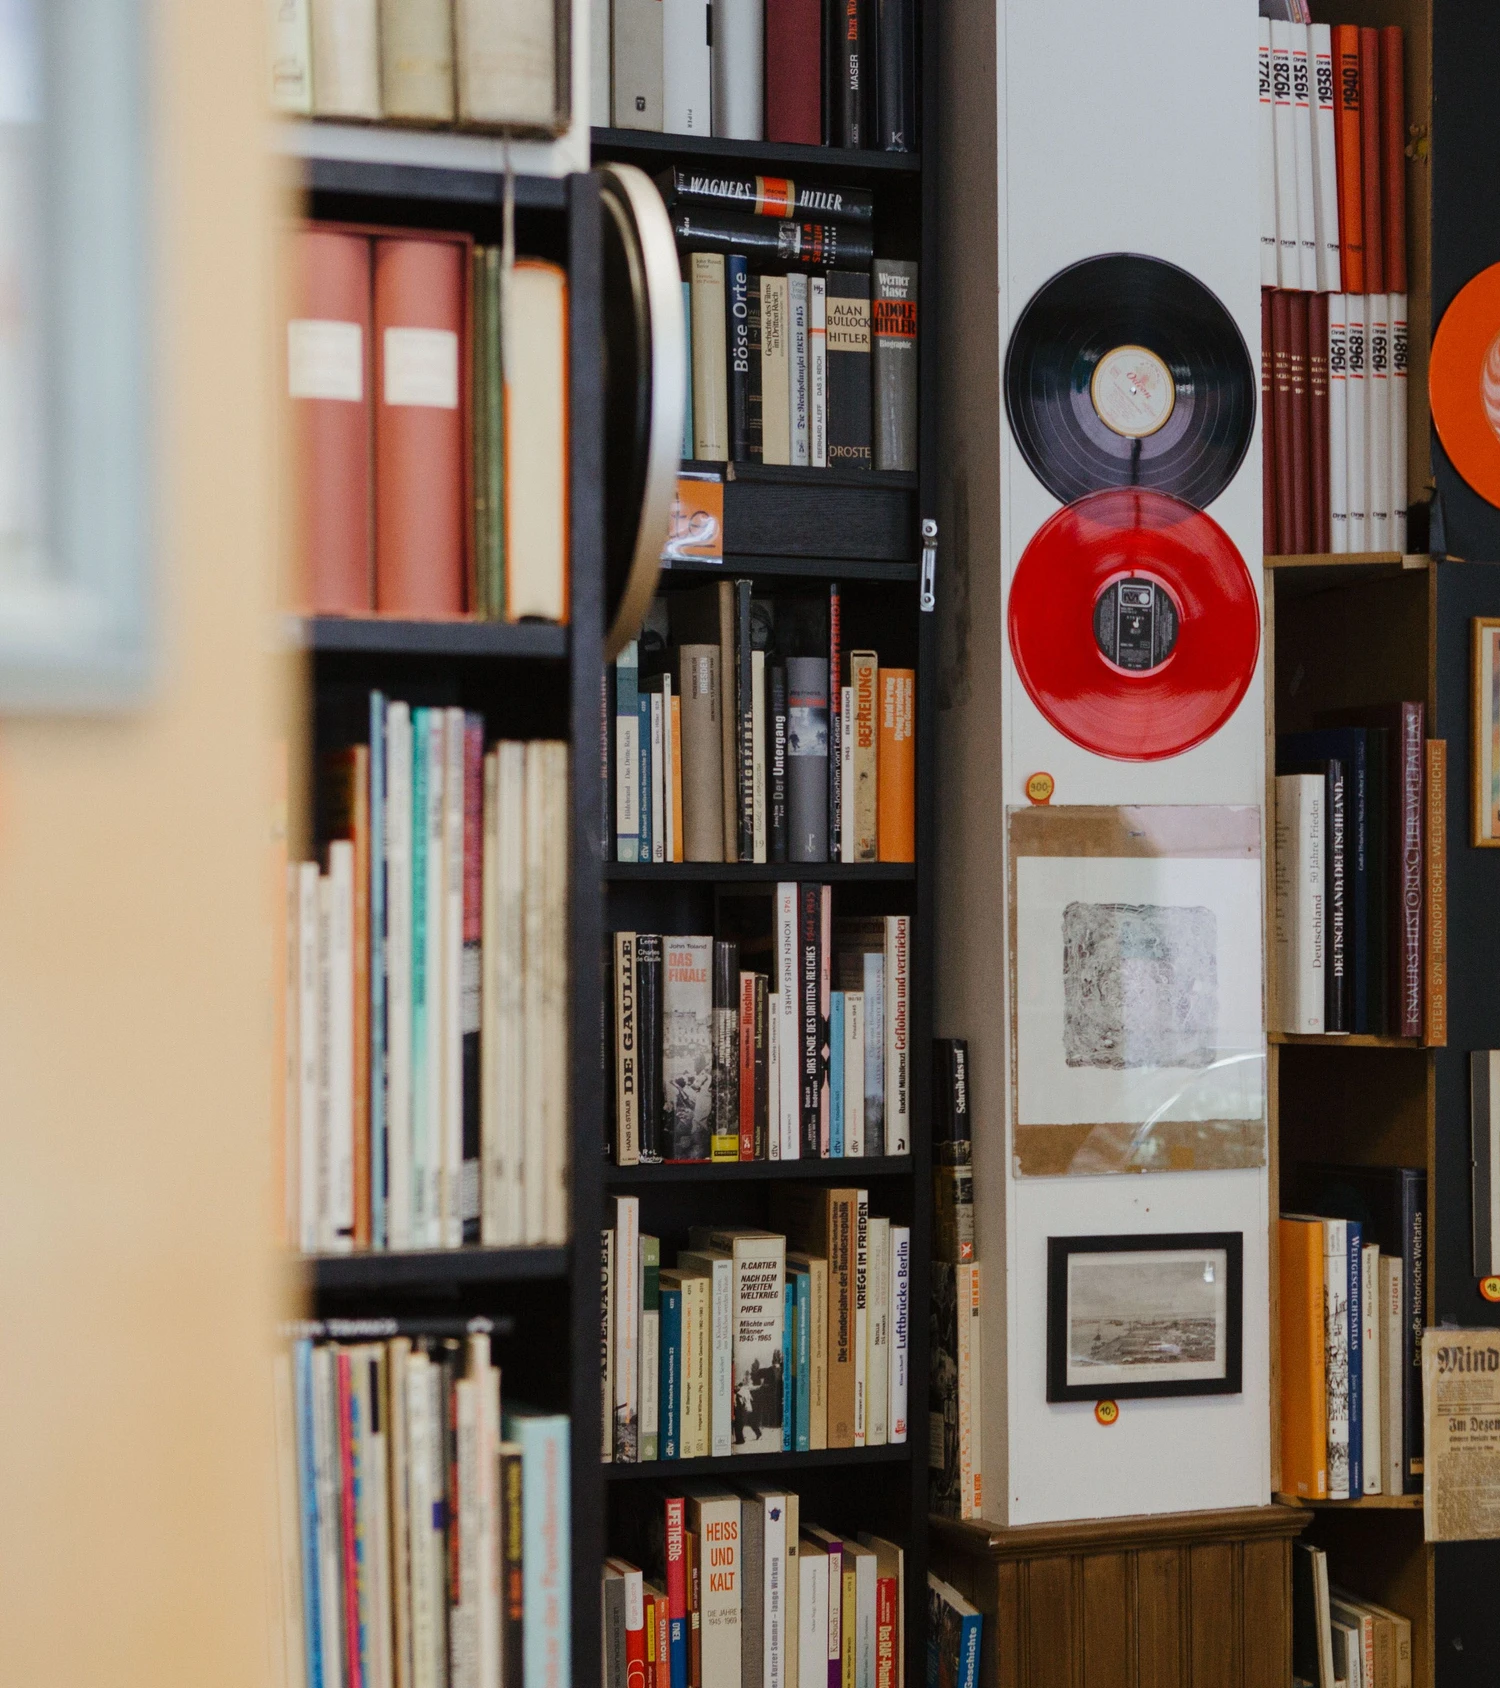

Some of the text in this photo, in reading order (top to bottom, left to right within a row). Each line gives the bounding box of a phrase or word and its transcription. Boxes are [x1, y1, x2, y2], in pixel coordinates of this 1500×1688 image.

[850, 54, 859, 90] MASER
[1274, 63, 1290, 100] 1928
[1294, 65, 1309, 101] 1935
[1317, 68, 1333, 103] 1938
[1343, 68, 1359, 106] 1940
[690, 176, 843, 212] WAGNERS HITLER
[878, 272, 910, 287] Werner
[881, 286, 908, 298] Maser
[772, 292, 780, 311] Reich
[834, 306, 862, 315] ALAN
[876, 303, 915, 318] ADOLF
[732, 272, 748, 372] Böse Orte
[764, 284, 772, 356] Geschichte des Films
[772, 312, 780, 338] Dritten
[827, 316, 871, 326] BULLOCK
[874, 318, 915, 334] HITLER
[829, 333, 869, 344] HITLER
[879, 340, 912, 350] Biographie
[1331, 336, 1346, 373] 1961
[1349, 336, 1364, 373] 1968
[1372, 336, 1387, 372] 1939
[829, 446, 871, 458] DROSTE
[700, 657, 708, 694] DRESDEN
[858, 668, 872, 748] BEFREIUNG
[772, 715, 787, 800] Der Untergang
[640, 845, 649, 859] dtv
[654, 844, 663, 858] dtv
[1404, 714, 1420, 1023] KNAURS HISTORISCHER WELTATLAS
[1309, 799, 1322, 969] Deutschland 50 Jahre Frieden
[1432, 748, 1443, 1038] PETERS SYNCHRONOPTISCHE WELTGESCHICHTE
[784, 920, 792, 954] IKONEN
[668, 952, 692, 966] DAS
[784, 958, 792, 982] EINES
[668, 968, 707, 982] FINALE
[742, 979, 753, 1025] Hiroshima
[784, 984, 792, 1015] JAHRES
[806, 946, 816, 1074] DAS ENDE DES DRITTEN REICHES
[622, 940, 634, 1095] DE GAULLE
[894, 919, 906, 1114] Rudolf Geflohen und vertrieben
[954, 1048, 966, 1114] Schreib das auf
[770, 1144, 778, 1158] dtv
[834, 1140, 842, 1154] dtv
[850, 1140, 858, 1153] dtv
[857, 1202, 868, 1310] KRIEGE IM FRIEDEN
[1412, 1212, 1423, 1315] historische Weltatlas
[741, 1274, 777, 1283] NACH DEM
[741, 1282, 773, 1292] ZWEITEN
[838, 1201, 849, 1363] Die Gründerjahre der Bundesrepublik
[740, 1290, 778, 1300] WELTKRIEG
[896, 1241, 908, 1349] Luftbrücke Berlin
[740, 1305, 762, 1314] PIPER
[739, 1327, 764, 1335] Männer
[740, 1320, 774, 1328] Mächte und
[1449, 1418, 1466, 1432] Im
[666, 1442, 675, 1456] dtv
[706, 1521, 737, 1542] HEISS
[710, 1548, 734, 1567] UND
[710, 1572, 735, 1593] KALT
[707, 1608, 738, 1618] DIE JAHRE
[830, 1616, 840, 1653] Kursbuch
[879, 1626, 891, 1641] Das
[964, 1626, 977, 1688] Geschichte
